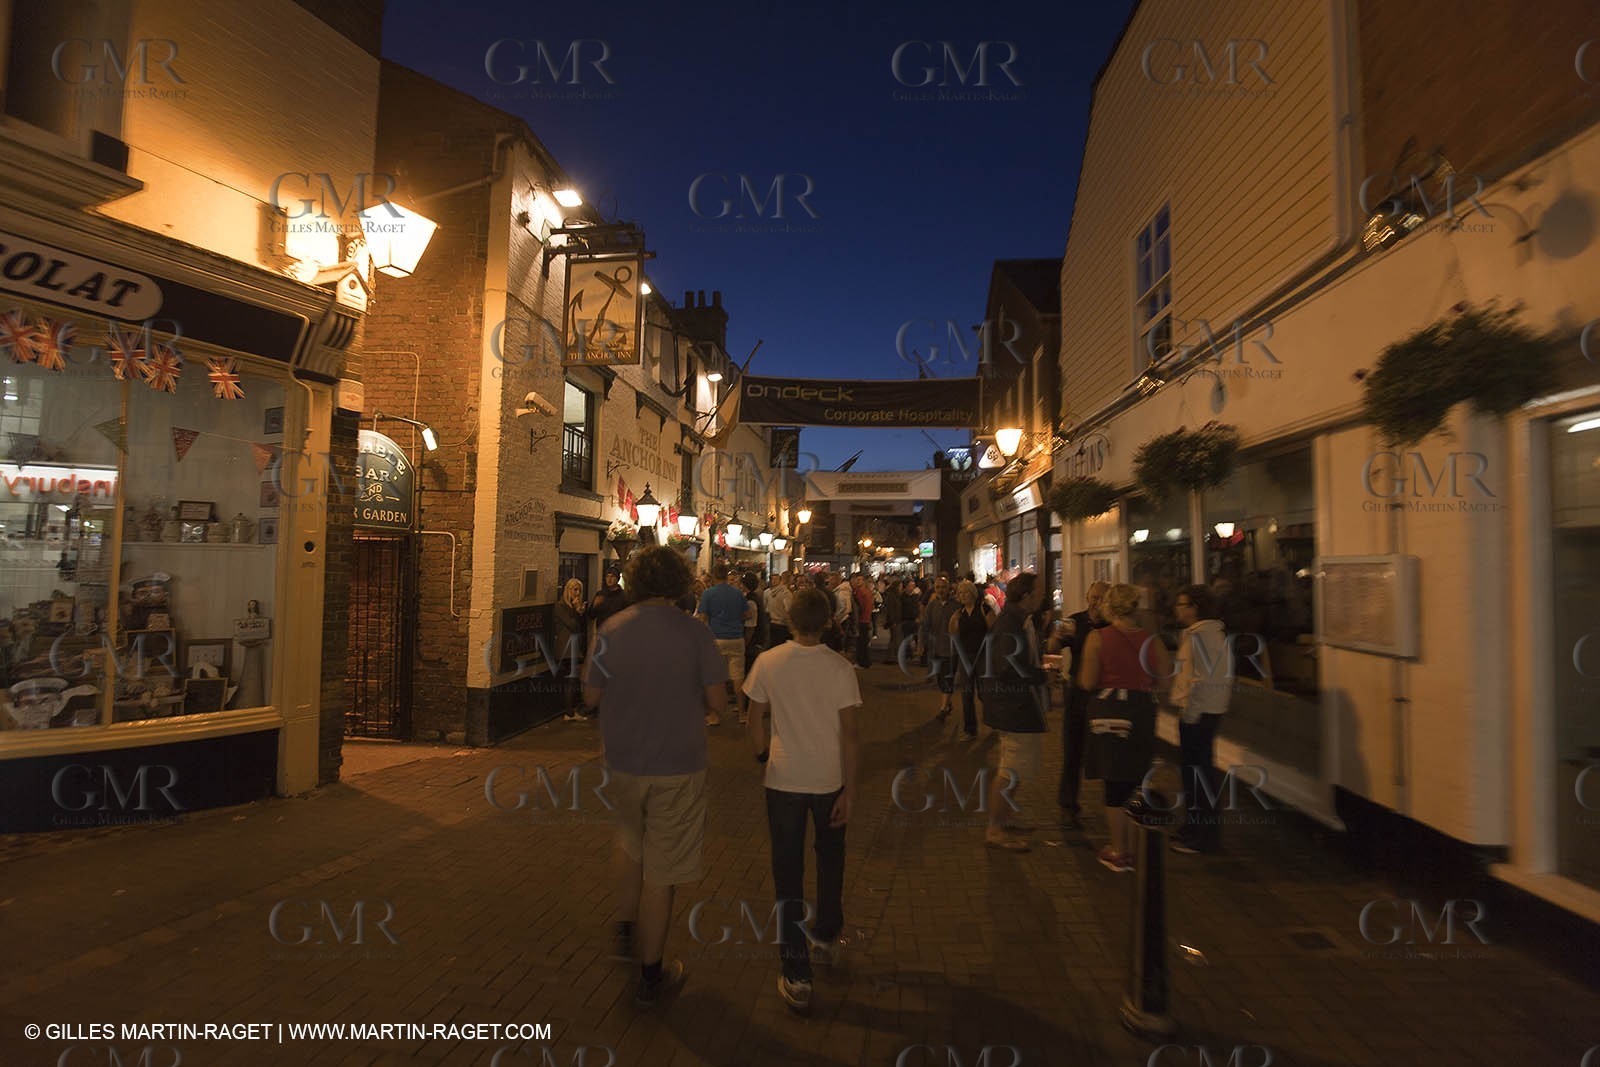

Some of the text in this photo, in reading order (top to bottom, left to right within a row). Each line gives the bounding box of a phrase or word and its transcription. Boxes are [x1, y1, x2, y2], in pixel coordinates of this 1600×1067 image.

[0, 243, 141, 307] OLAT
[618, 351, 632, 359] INN
[746, 384, 855, 401] ondeck
[824, 408, 973, 424] Corporate Hospitality
[640, 427, 657, 451] THE
[609, 434, 661, 476] ANCHOR
[362, 507, 407, 523] GARDEN
